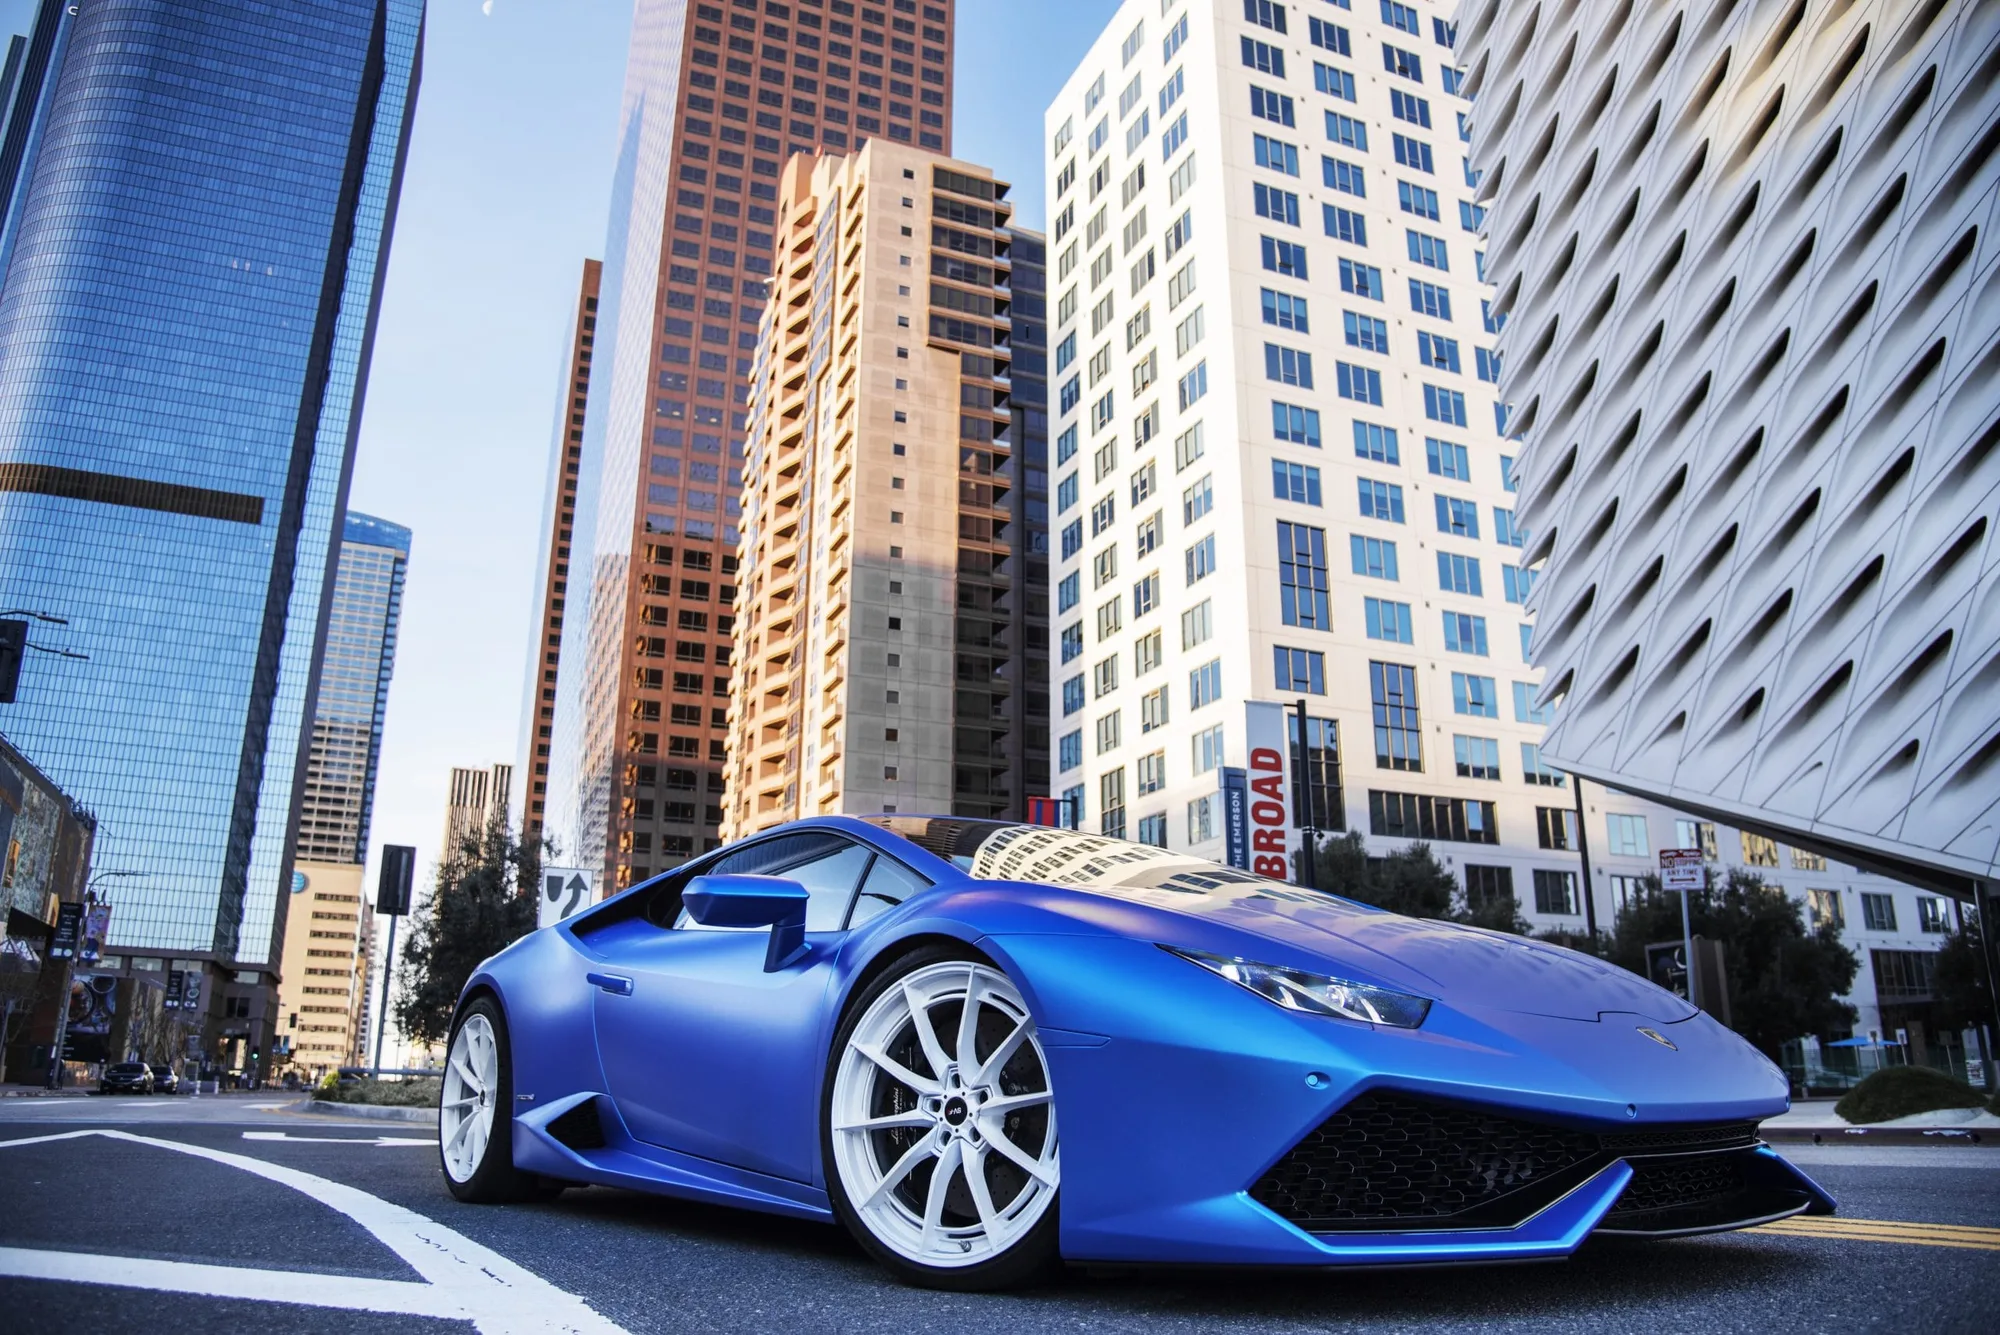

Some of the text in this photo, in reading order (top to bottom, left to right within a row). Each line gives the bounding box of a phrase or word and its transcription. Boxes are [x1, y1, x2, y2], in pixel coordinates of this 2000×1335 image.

[1232, 791, 1242, 844] EMERSON
[1251, 747, 1287, 880] BROAD
[1661, 857, 1674, 868] NO
[1683, 868, 1698, 876] TIME
